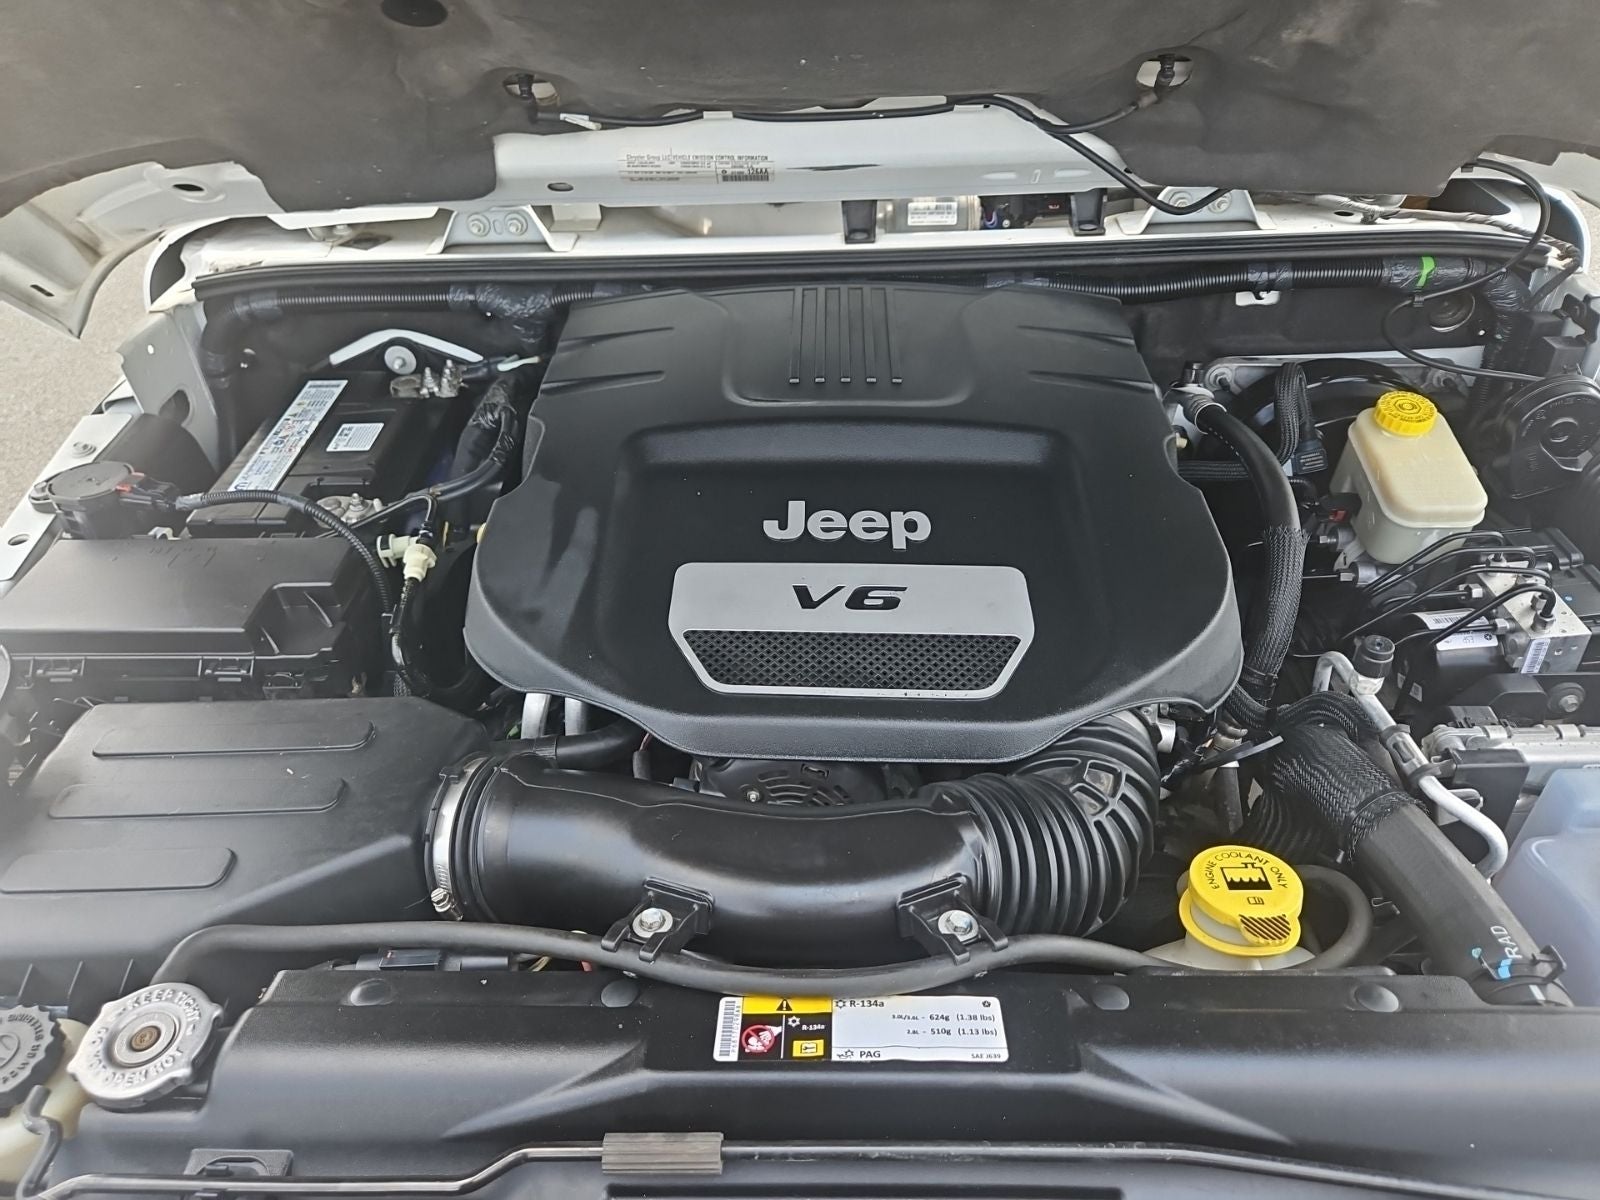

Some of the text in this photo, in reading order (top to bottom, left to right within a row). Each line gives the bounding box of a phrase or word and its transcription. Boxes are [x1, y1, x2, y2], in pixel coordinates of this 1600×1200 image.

[763, 500, 932, 550] Jeep
[792, 584, 908, 611] V6
[1205, 851, 1288, 890] ENGINE COOLANT ONLY
[1490, 925, 1523, 959] RAD
[849, 999, 885, 1008] R-134a
[929, 1014, 950, 1022] 624g
[956, 1013, 978, 1022] (1.38
[980, 1013, 996, 1022] lbs)
[930, 1028, 951, 1036] 510g
[957, 1027, 979, 1036] (1.13
[981, 1027, 998, 1036] lbs)
[859, 1050, 881, 1059] PAG
